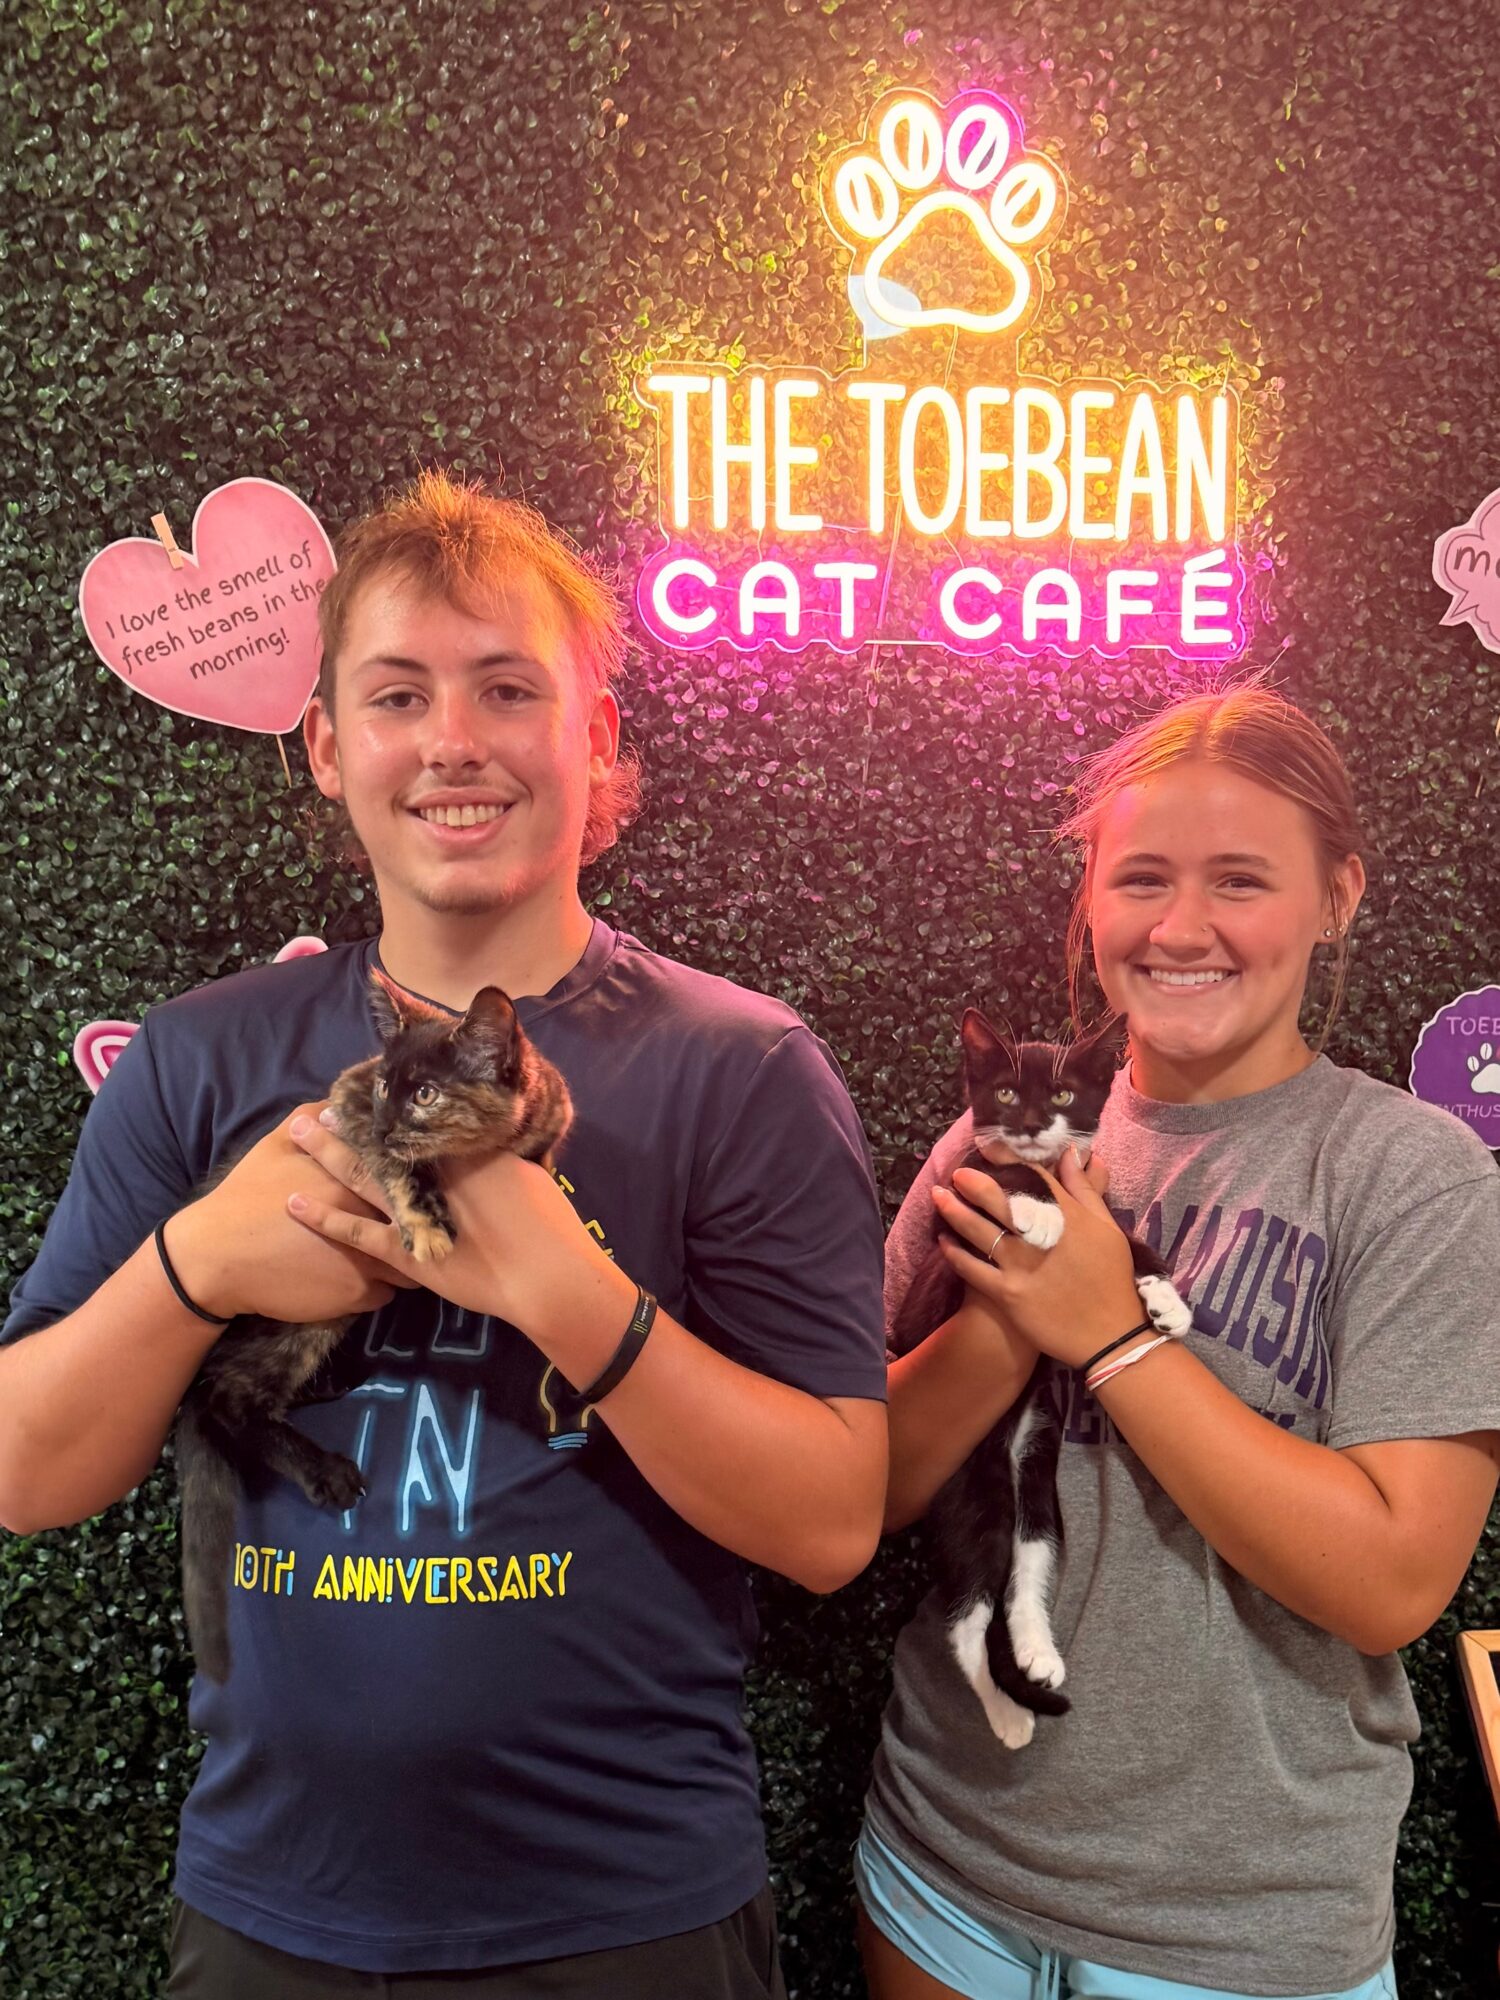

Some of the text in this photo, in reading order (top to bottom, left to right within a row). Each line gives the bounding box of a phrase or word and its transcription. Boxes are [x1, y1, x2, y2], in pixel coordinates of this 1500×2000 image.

[648, 374, 1227, 542] THE TOEBEAN
[105, 539, 311, 640] I love the smell of
[121, 579, 326, 675] fresh beans in the
[652, 547, 1233, 645] CAT CAFÉ
[189, 627, 291, 680] morning!
[234, 1542, 573, 1604] 10TH ANNIVERSARY
